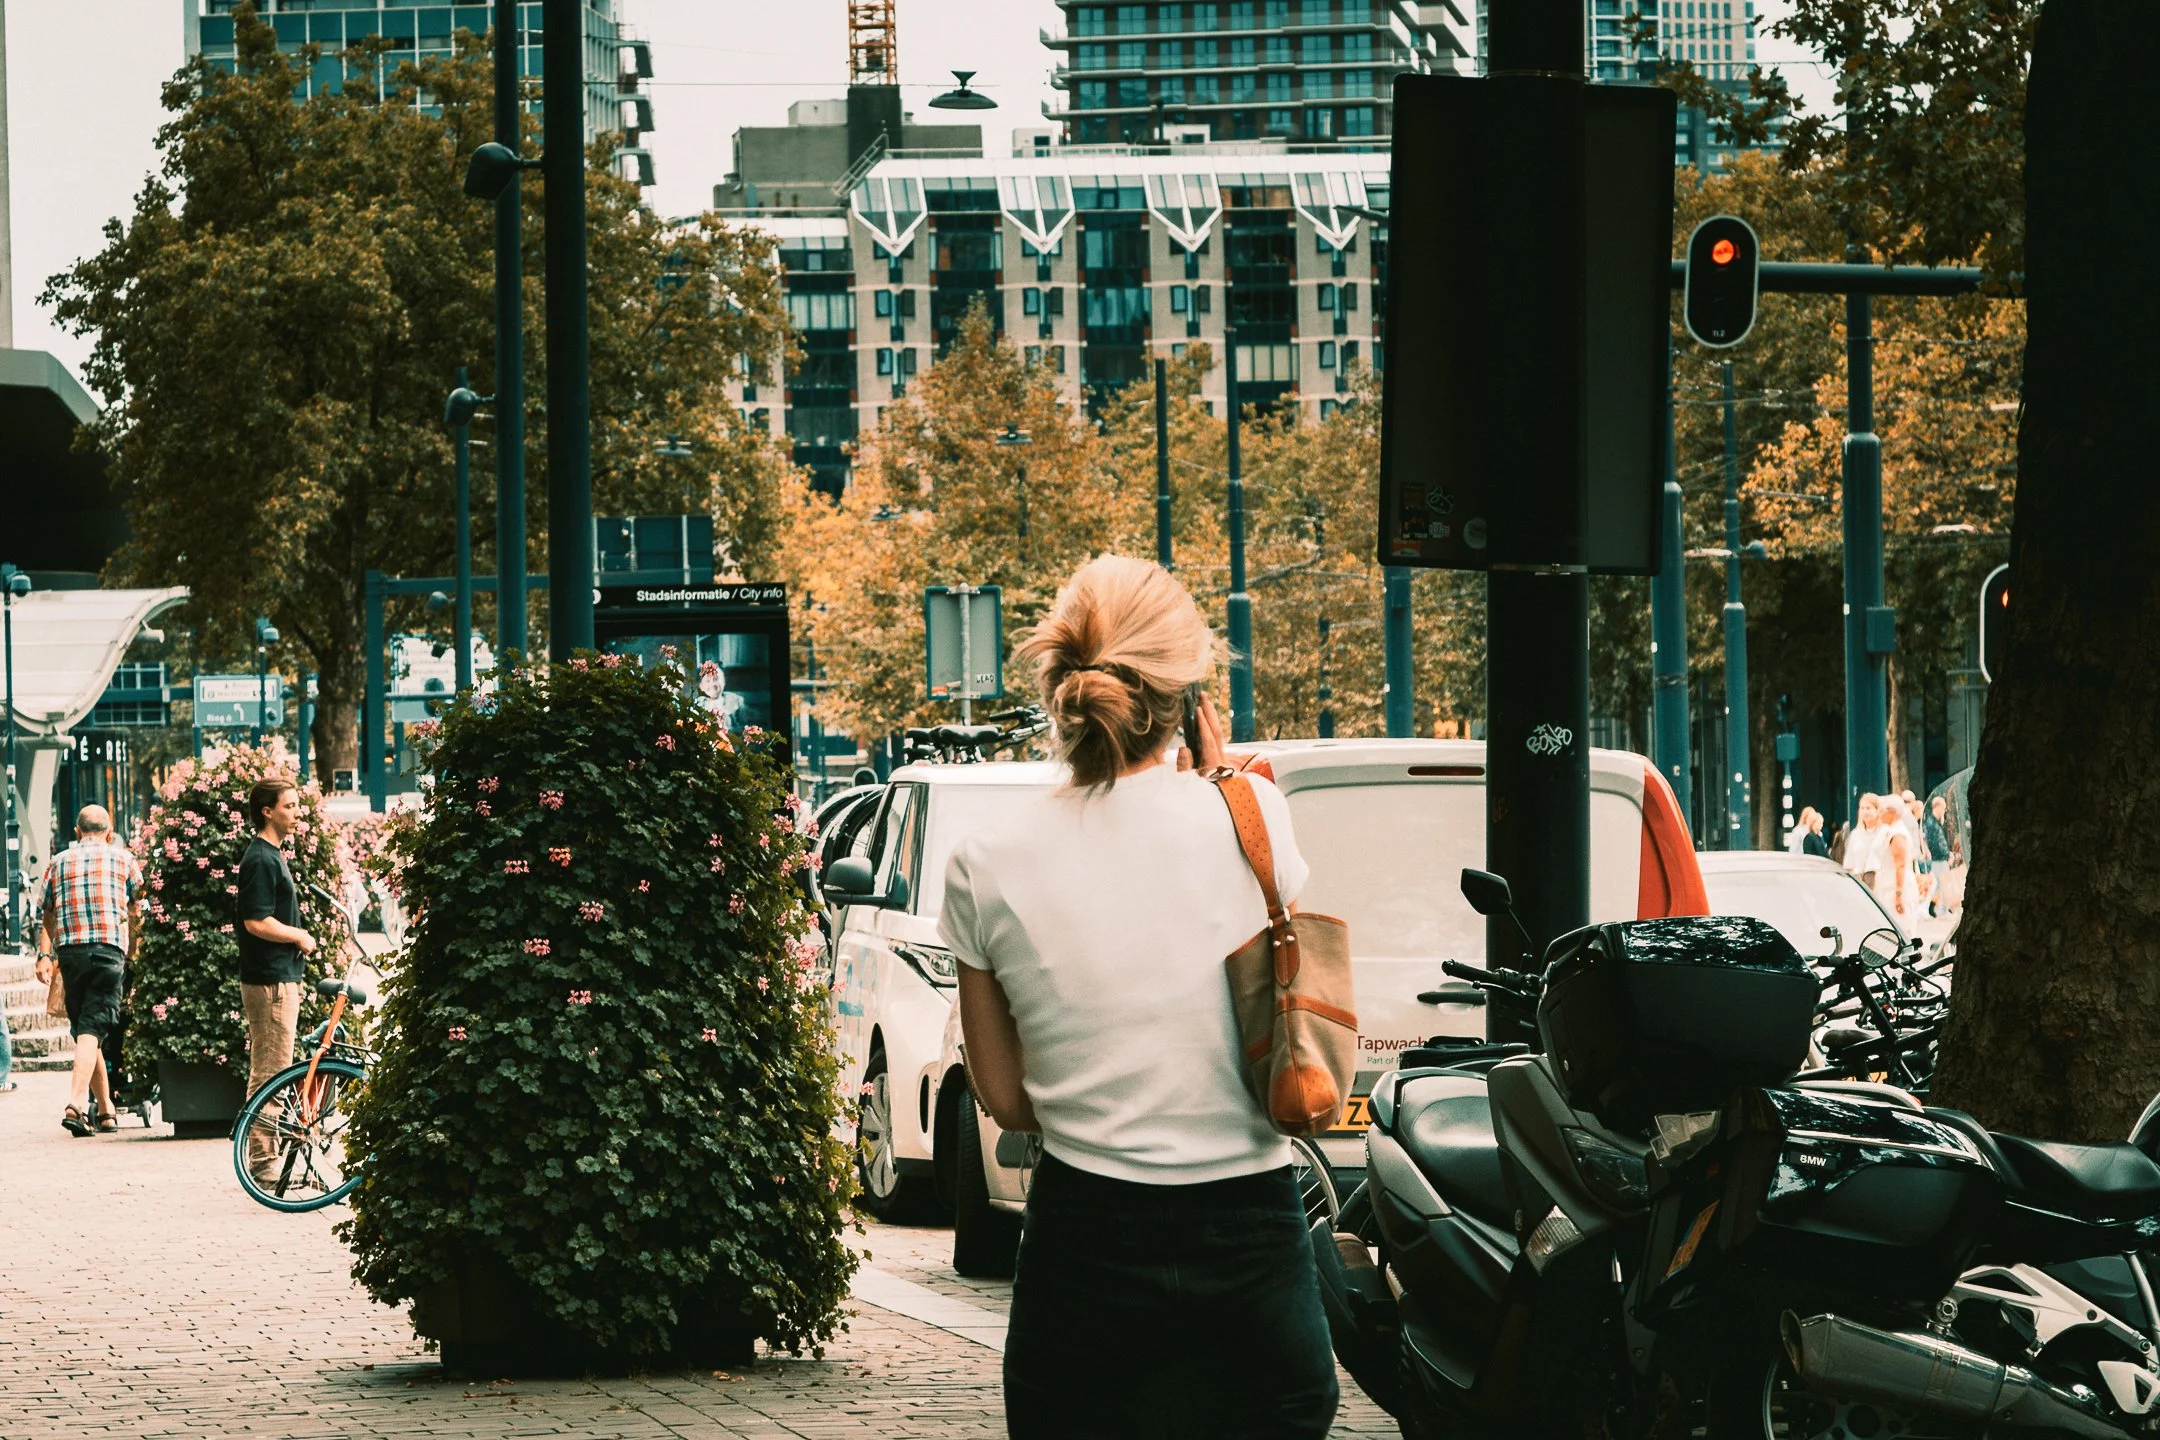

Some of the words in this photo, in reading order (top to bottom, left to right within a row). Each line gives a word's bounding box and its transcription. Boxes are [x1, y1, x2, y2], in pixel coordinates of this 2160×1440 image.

[636, 589, 730, 602] Stadsinformatie
[740, 588, 761, 601] City
[763, 588, 784, 599] info
[1367, 1056, 1383, 1064] Part
[1385, 1056, 1394, 1064] of
[1799, 1154, 1827, 1167] BMW
